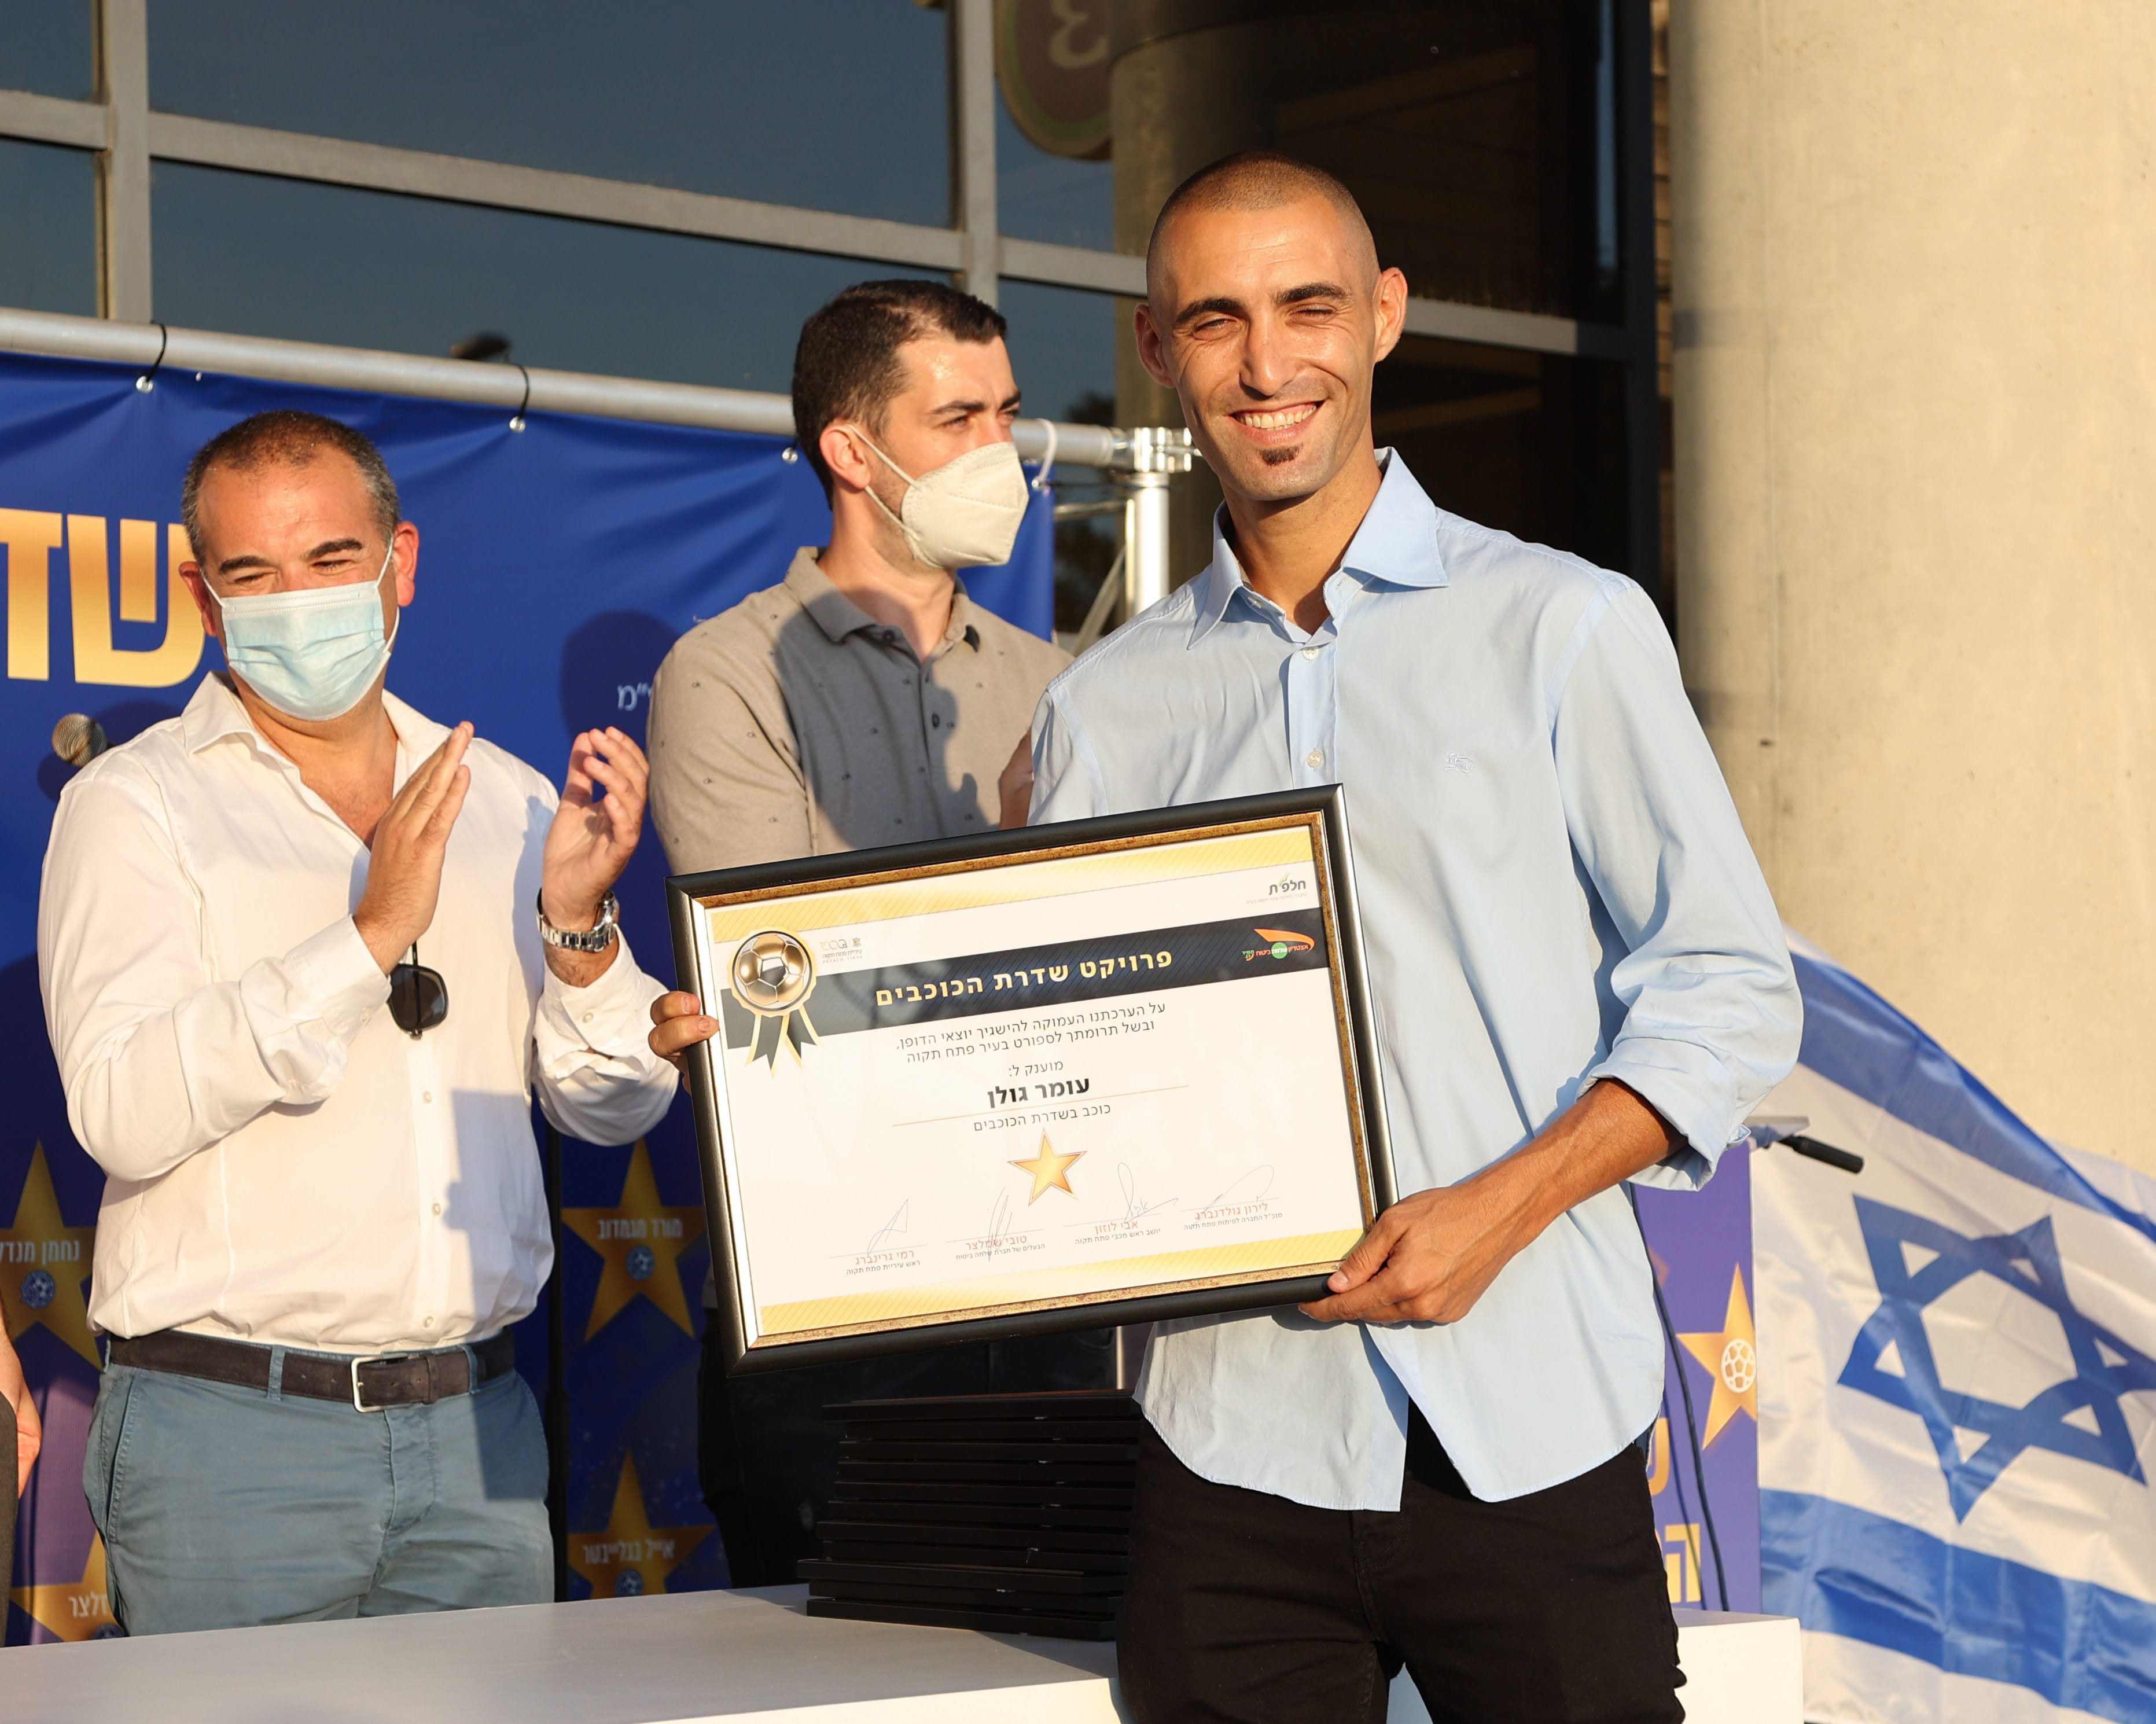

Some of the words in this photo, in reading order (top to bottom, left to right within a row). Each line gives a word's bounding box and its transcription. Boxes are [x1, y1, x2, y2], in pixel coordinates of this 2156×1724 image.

[1080, 951, 1172, 979] פרויקט
[994, 965, 1069, 990] שדרת
[875, 977, 984, 1006] הכוכבים
[1090, 1006, 1145, 1022] הערכתנו
[1149, 1002, 1165, 1014] על
[1033, 1014, 1085, 1030] העמוקה
[1122, 1021, 1154, 1033] ובשל
[941, 1030, 972, 1042] יוצאי
[977, 1020, 1028, 1039] להישגיך
[1066, 1025, 1119, 1042] תרומתך
[1014, 1031, 1062, 1049] לספורט
[945, 1045, 975, 1058] פתח
[979, 1041, 1010, 1053] בעיר
[907, 1050, 941, 1063] תקוה
[1025, 1061, 1064, 1076] מוענק
[1035, 1078, 1090, 1098] עומר
[987, 1086, 1028, 1109] גולן
[1031, 1109, 1078, 1124] בשדרת
[1083, 1104, 1111, 1117] כוכב
[974, 1116, 1027, 1131] הכוכבים
[1195, 1207, 1241, 1220] גולדנברג
[1244, 1201, 1268, 1215] לירון
[1121, 1220, 1139, 1230] אבי
[1217, 1217, 1240, 1226] לפיתוח
[1095, 1222, 1117, 1235] לוזון
[1005, 1235, 1027, 1245] טובי
[1094, 1234, 1110, 1243] פתח
[1112, 1232, 1128, 1240] מכבי
[965, 1238, 1002, 1251] שמלצר
[1022, 1243, 1046, 1252] הבעלים
[41, 1240, 81, 1266] נחמן
[855, 1253, 893, 1265] גרינברג
[896, 1250, 914, 1259] רמי
[974, 1250, 992, 1258] שלמה
[883, 1262, 904, 1270] עיריית
